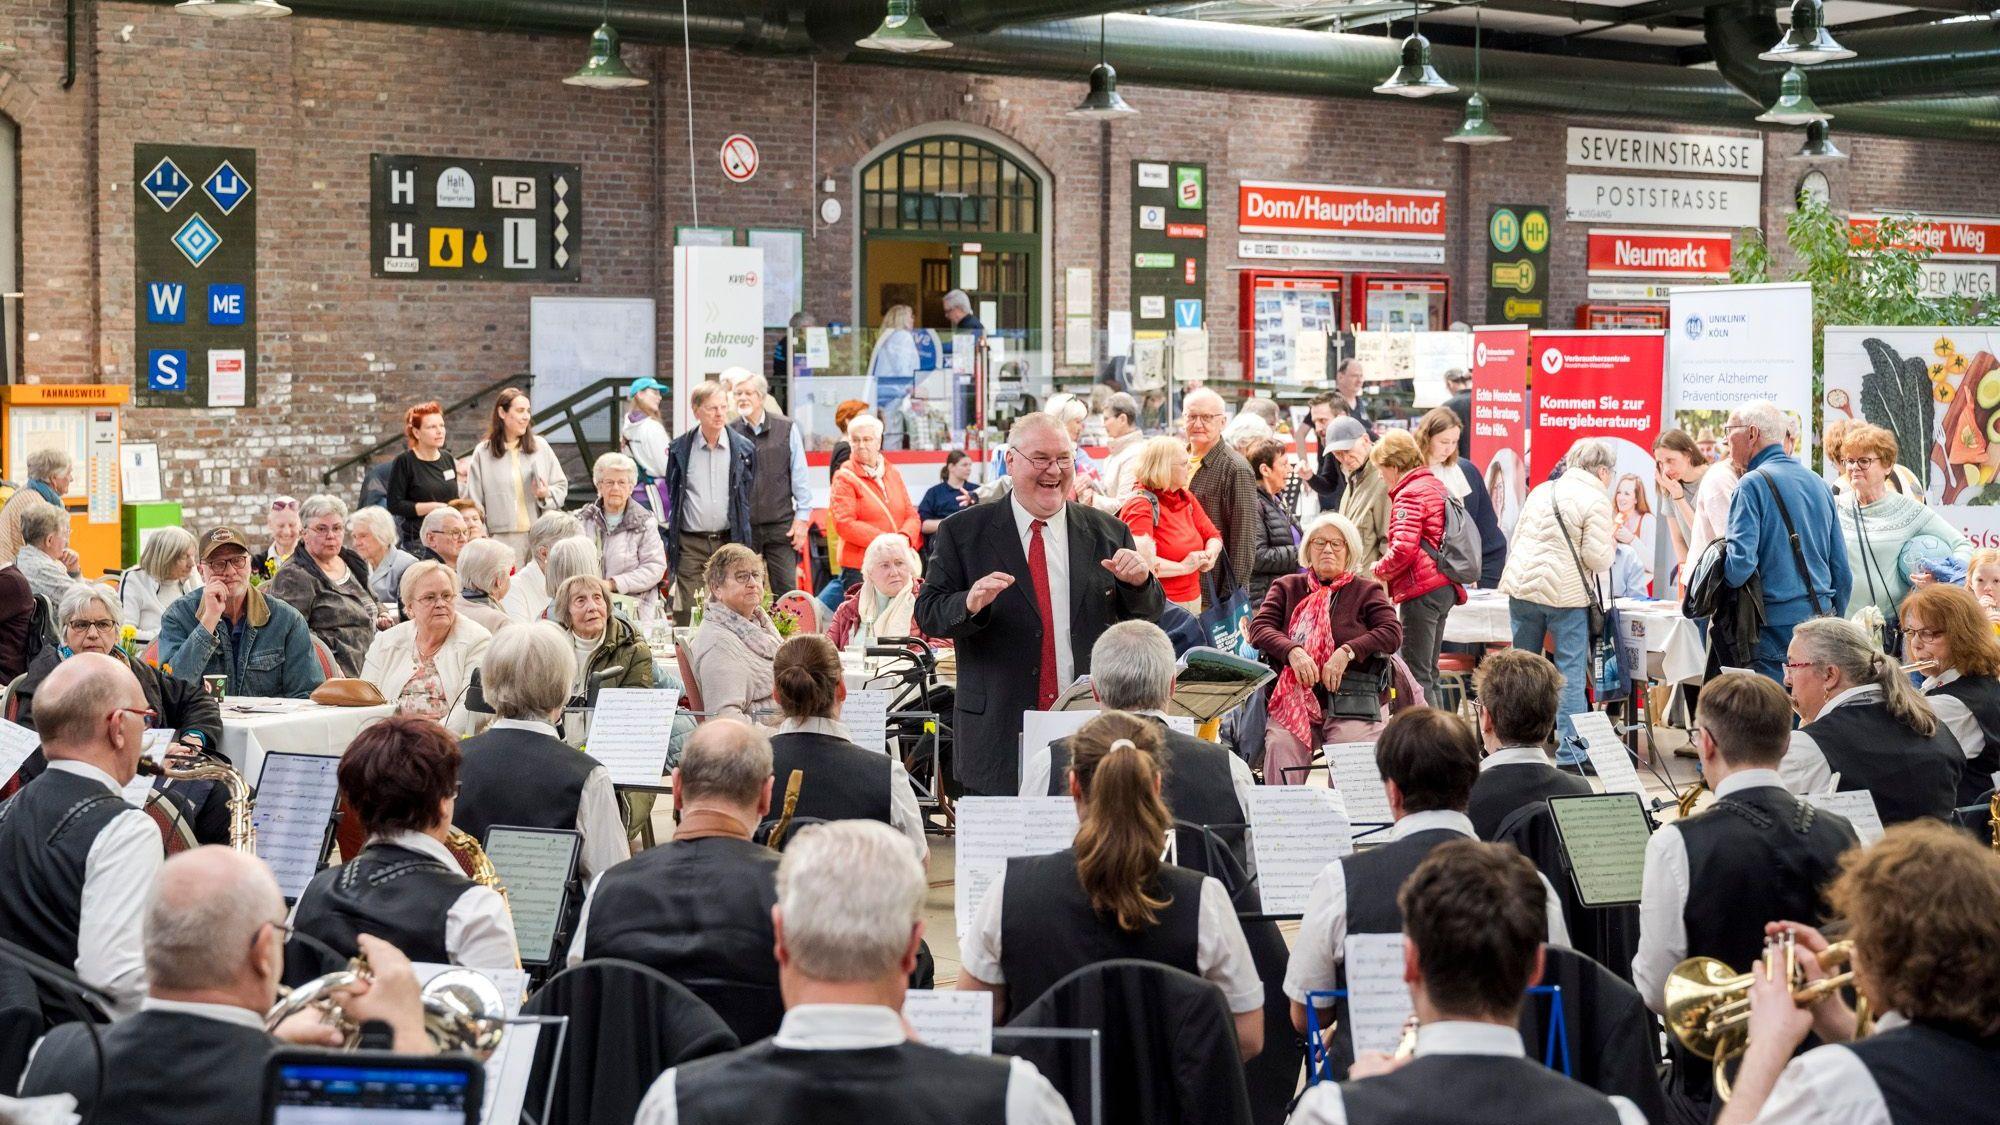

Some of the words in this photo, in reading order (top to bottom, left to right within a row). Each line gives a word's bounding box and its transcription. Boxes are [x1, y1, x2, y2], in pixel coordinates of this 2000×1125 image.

[1580, 136, 1749, 169] SEVERINSTRASSE
[391, 170, 414, 204] H
[446, 175, 465, 188] Halt
[498, 181, 531, 204] LP
[1596, 186, 1728, 210] POSTSTRASSE
[1247, 192, 1441, 227] Dom/Hauptbahnhof
[390, 223, 413, 256] H
[1498, 220, 1511, 241] H
[1525, 222, 1545, 241] HH
[1950, 224, 1985, 253] Weg
[513, 221, 528, 264] L
[1614, 239, 1707, 268] Neumarkt
[1955, 272, 1990, 293] WEG
[151, 284, 182, 315] W
[213, 295, 241, 314] ME
[1180, 303, 1197, 326] V
[1708, 315, 1746, 324] UNIKLINIK
[704, 331, 758, 348] Fahrzeug-
[1708, 328, 1728, 337] KÖLN
[704, 345, 728, 358] Info
[1563, 354, 1631, 363] Verbraucherzentrale
[156, 354, 180, 386] S
[1683, 373, 1714, 384] Kölner
[1718, 372, 1768, 384] Alzheimer
[42, 389, 107, 398] FAHRAUSWEISE
[1540, 396, 1596, 409] Kommen
[1599, 396, 1619, 410] Sie
[1622, 399, 1645, 410] zur
[1539, 413, 1651, 430] Energieberatung!
